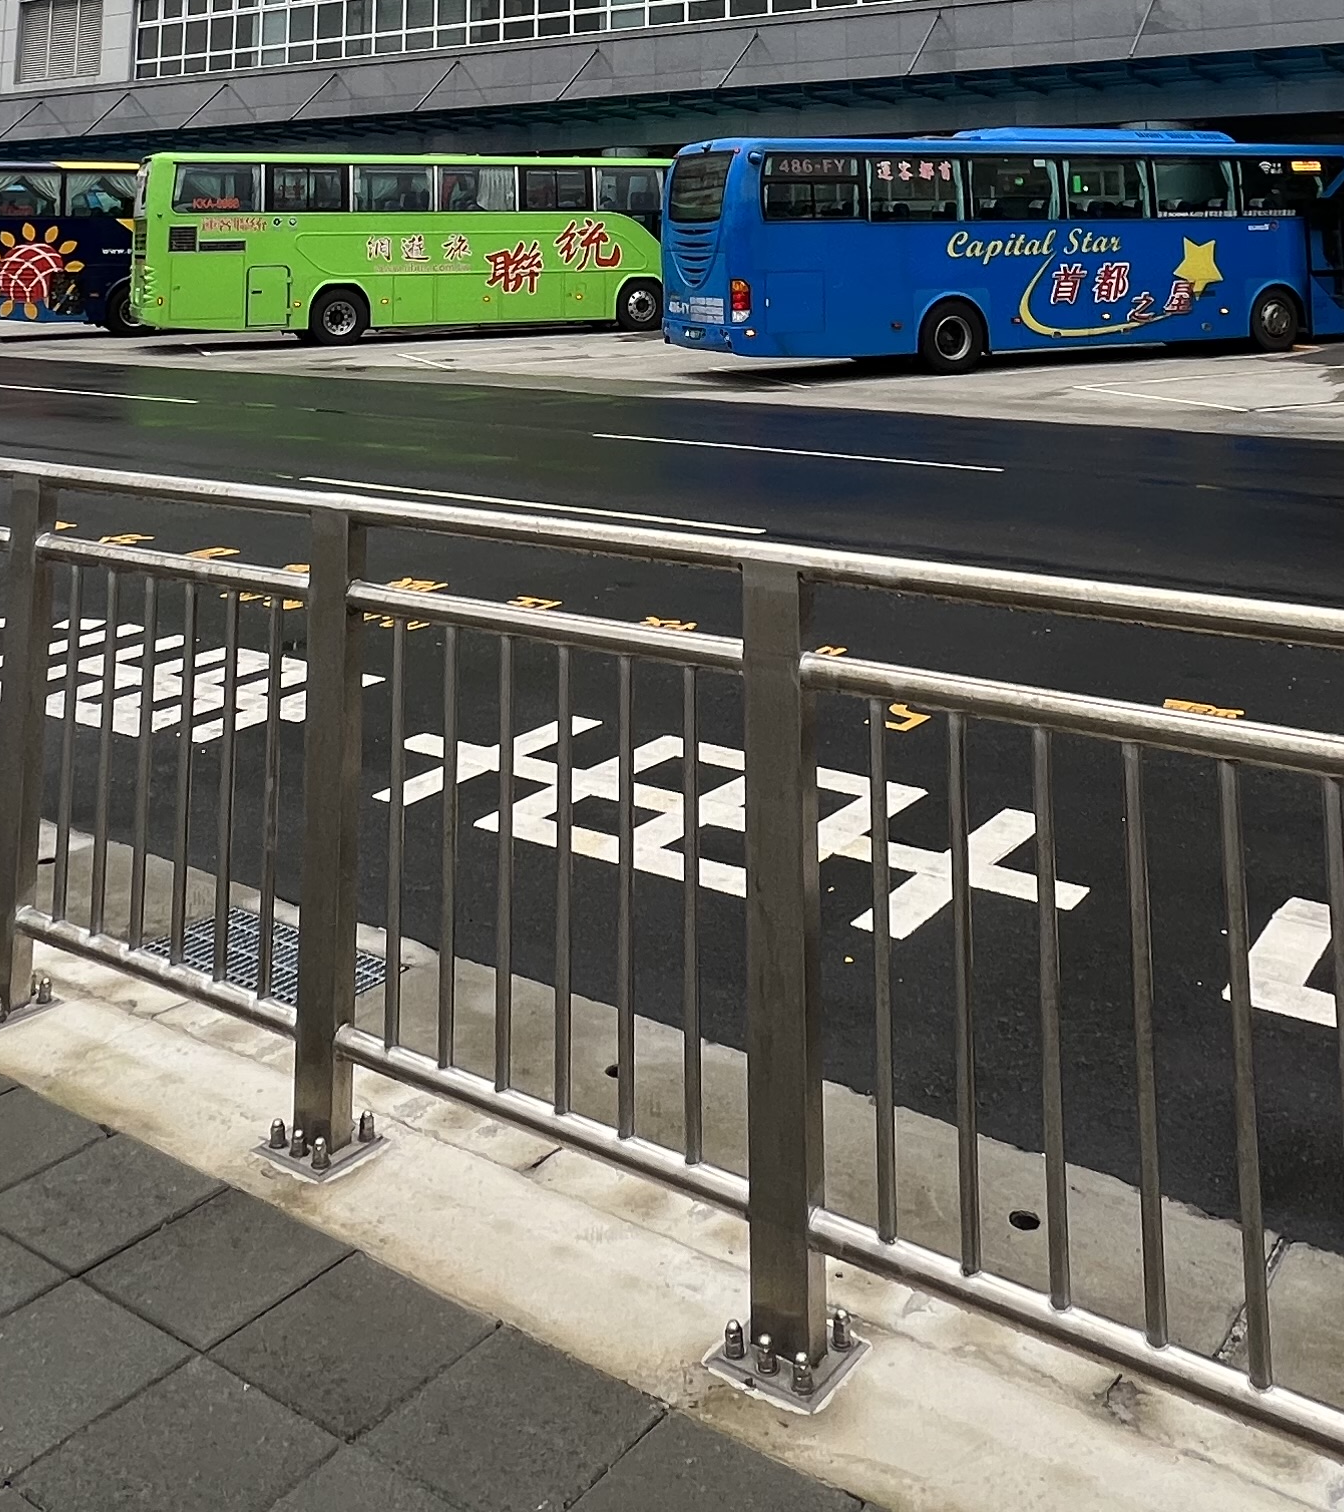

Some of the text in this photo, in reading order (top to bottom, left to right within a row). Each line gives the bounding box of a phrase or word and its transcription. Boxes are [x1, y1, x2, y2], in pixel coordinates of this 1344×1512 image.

[779, 158, 846, 174] 486-FY
[947, 228, 1123, 265] Capital Star
